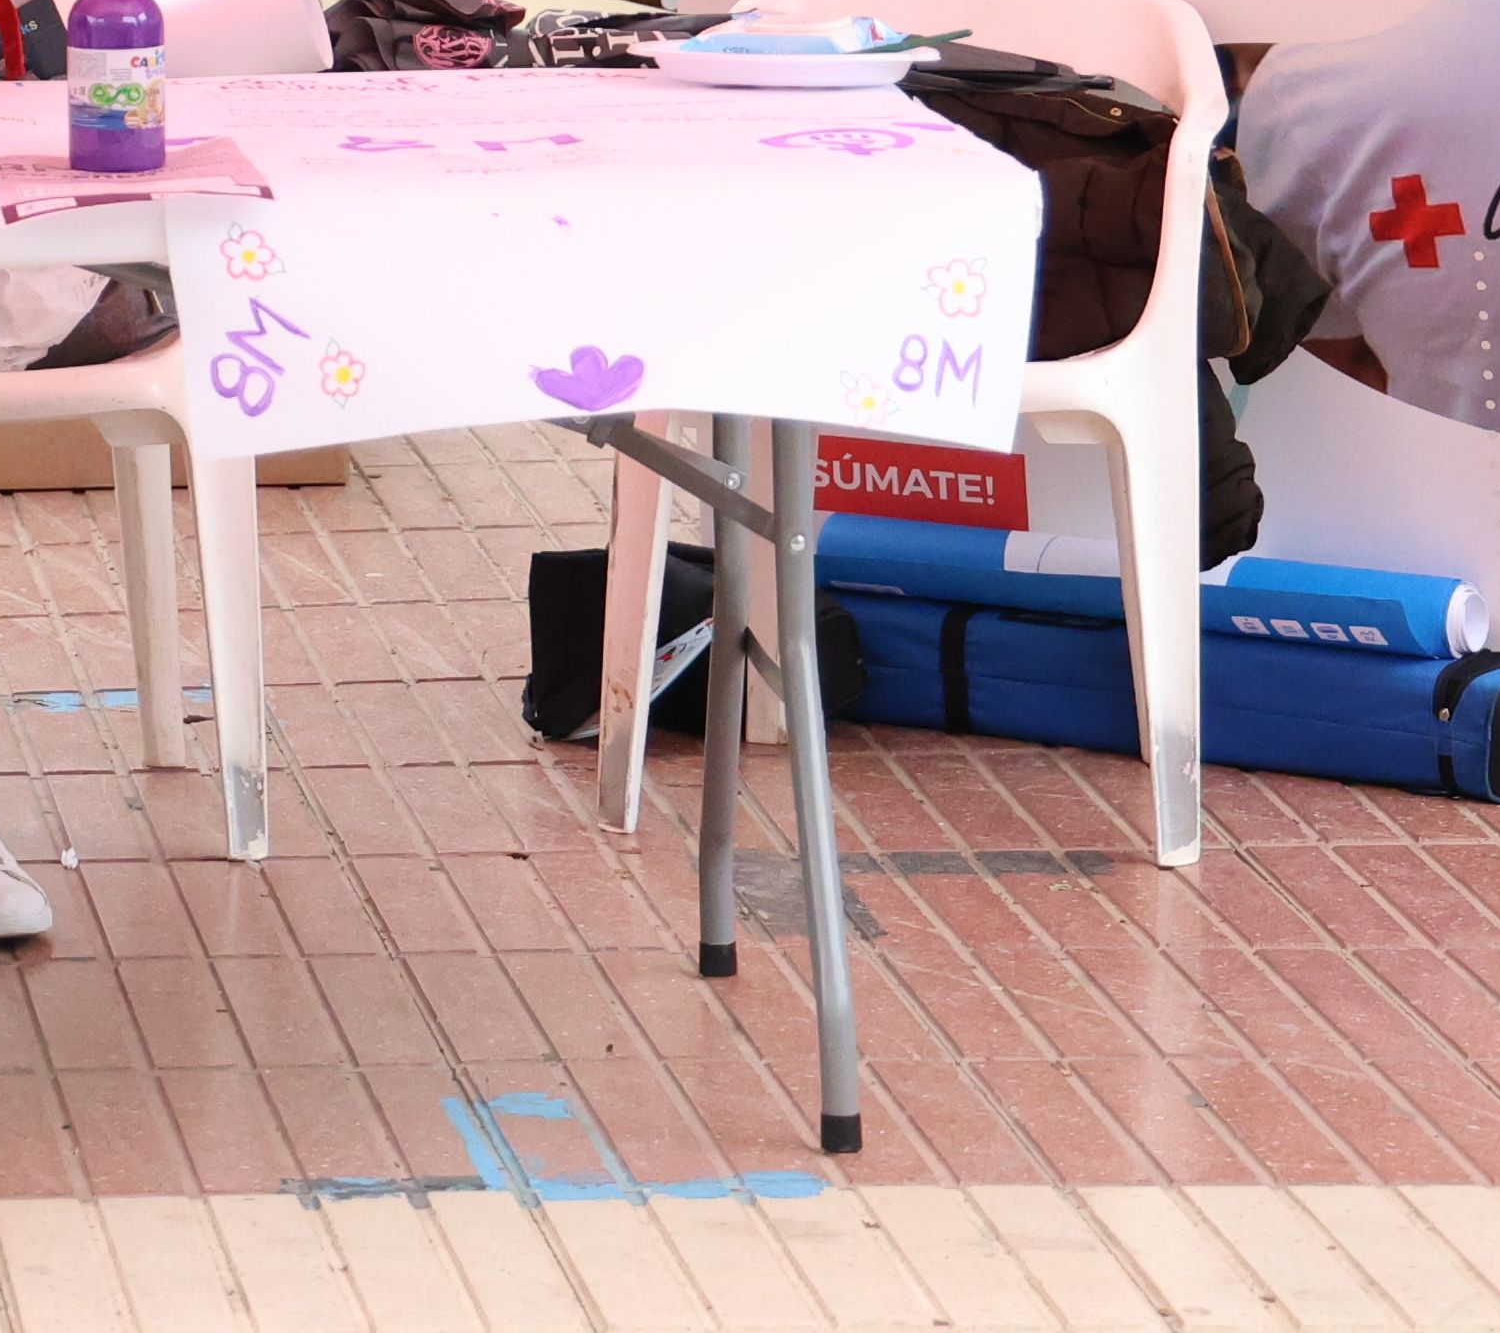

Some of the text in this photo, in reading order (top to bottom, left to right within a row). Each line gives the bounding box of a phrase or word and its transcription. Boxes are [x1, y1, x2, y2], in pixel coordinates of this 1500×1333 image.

[209, 295, 312, 418] 8M
[891, 333, 983, 409] 8M
[814, 452, 995, 506] SÚMATE!
